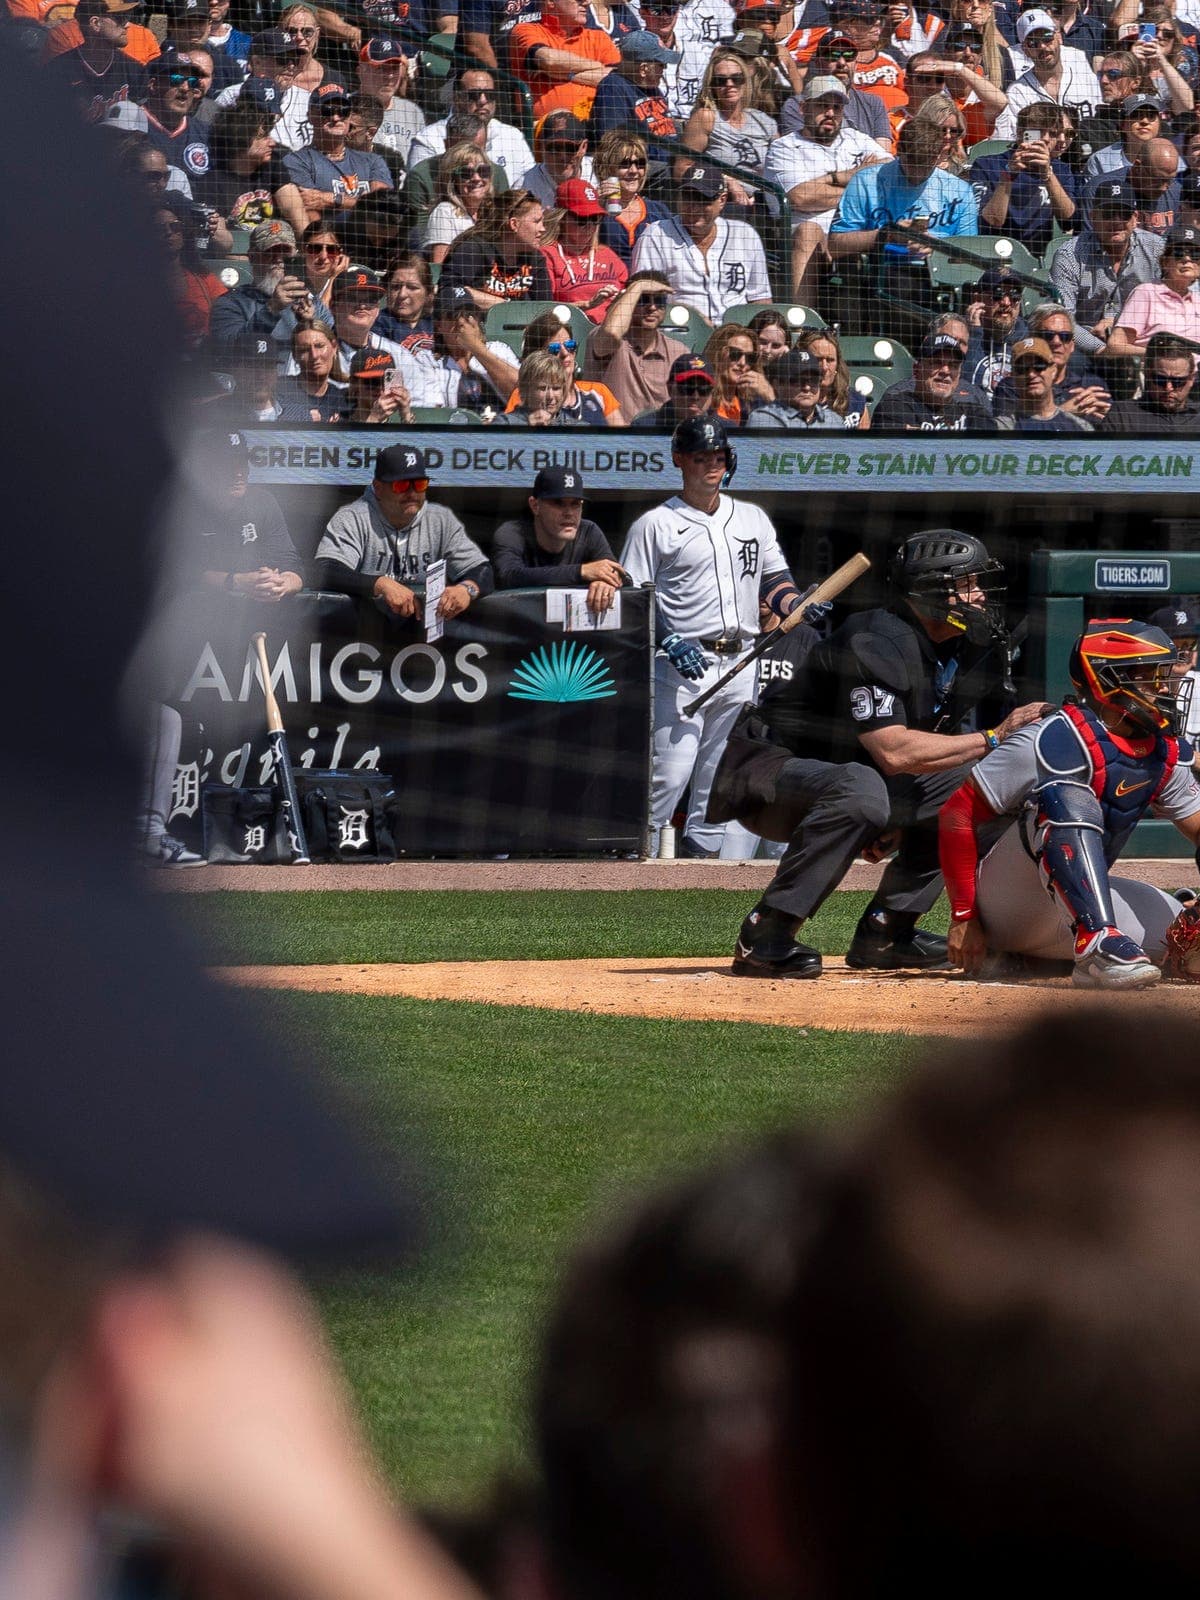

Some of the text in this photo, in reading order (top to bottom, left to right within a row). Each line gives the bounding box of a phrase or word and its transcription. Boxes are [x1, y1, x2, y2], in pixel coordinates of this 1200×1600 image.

[724, 262, 746, 294] D
[347, 447, 443, 469] SHD
[452, 447, 527, 471] DECK
[533, 449, 664, 472] BUILDERS
[758, 453, 1193, 477] NEVER STAIN YOUR DECK AGAIN
[733, 536, 759, 579] D
[1102, 565, 1164, 584] TIGERS.COM
[180, 641, 489, 703] AMIGOS
[850, 686, 895, 720] 37
[244, 825, 265, 853] D
[338, 805, 369, 849] D
